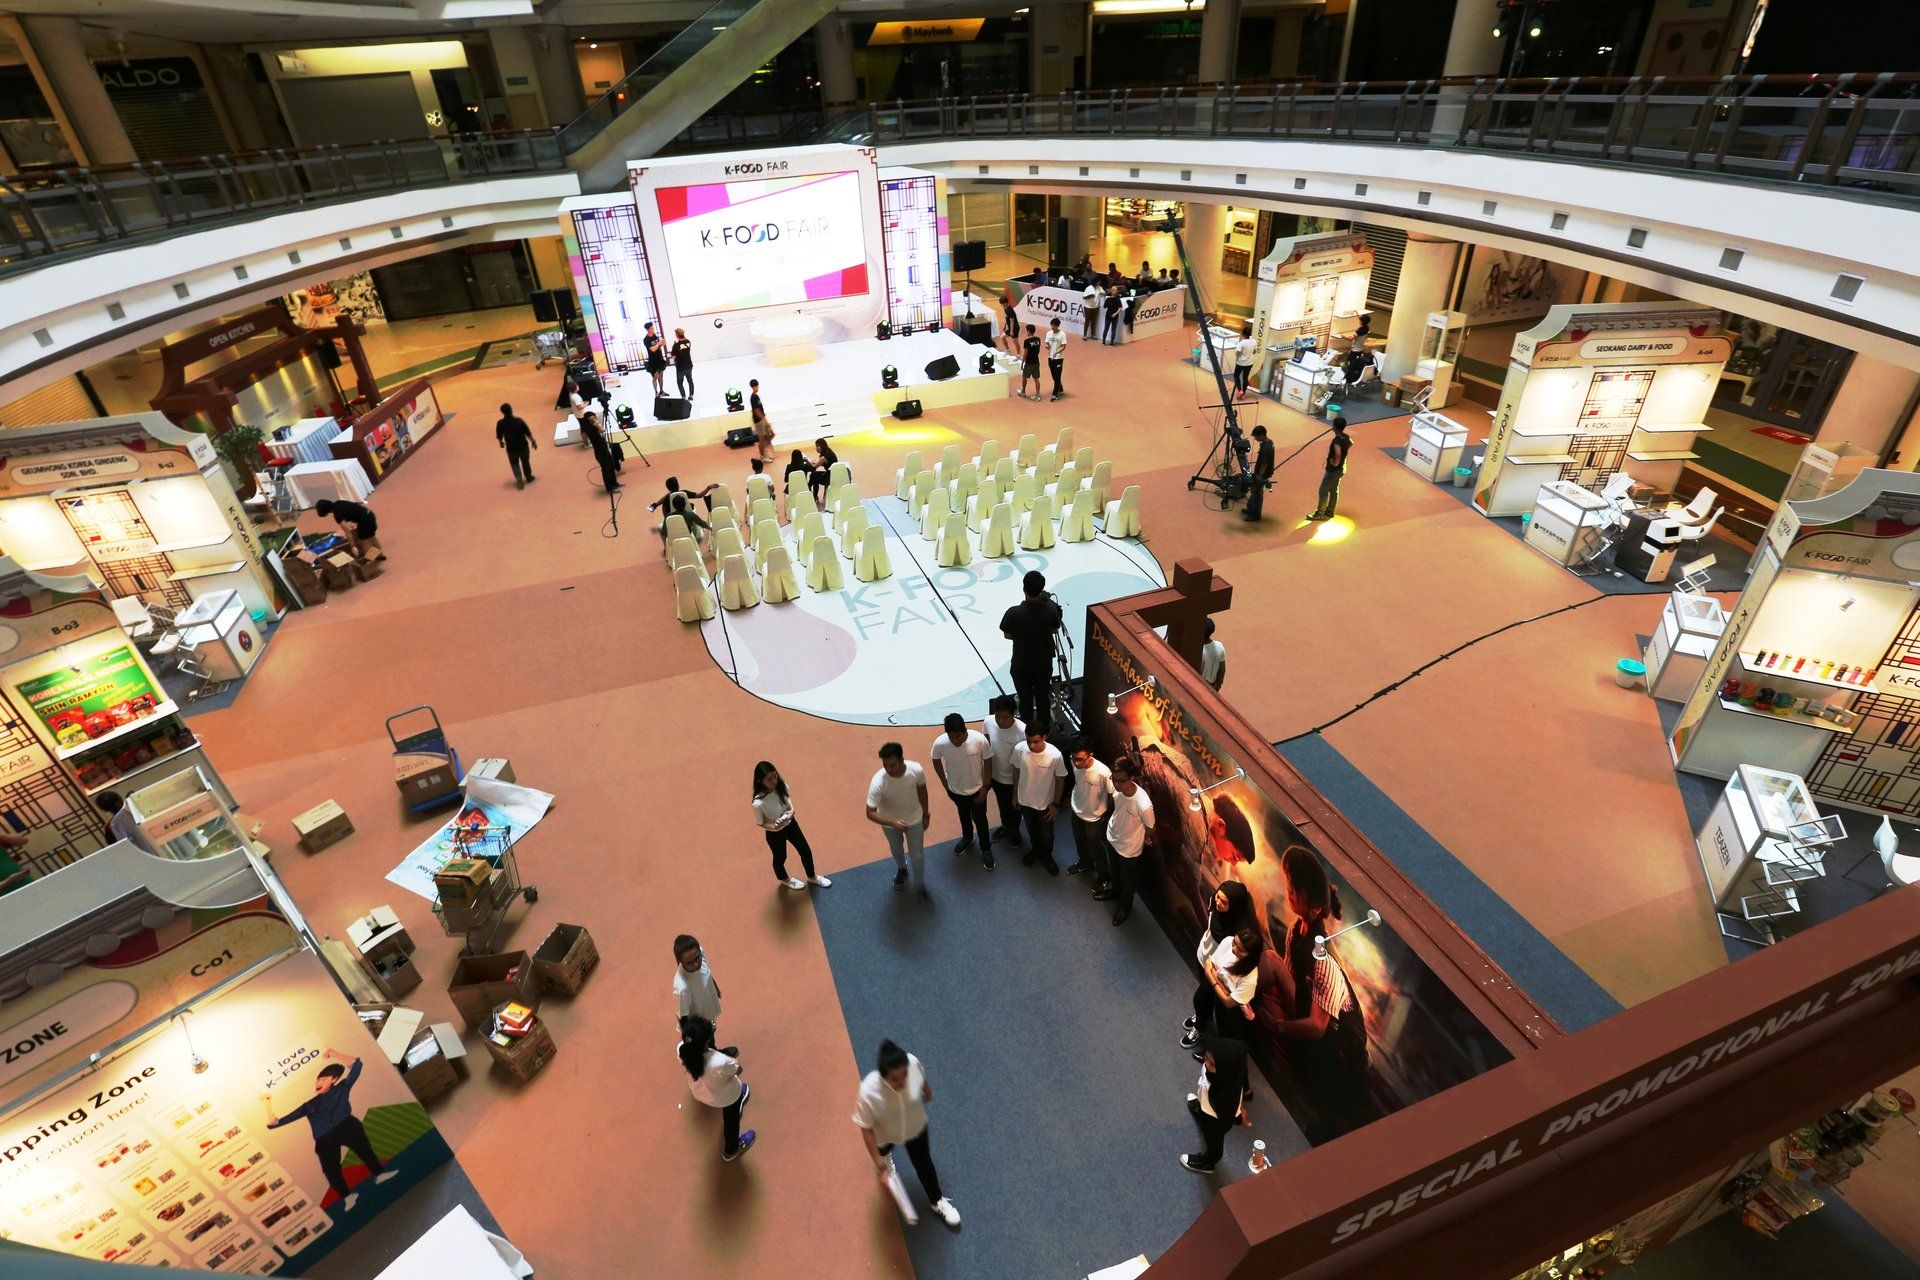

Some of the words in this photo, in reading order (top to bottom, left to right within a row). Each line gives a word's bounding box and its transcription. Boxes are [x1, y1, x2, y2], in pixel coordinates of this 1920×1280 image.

[913, 25, 954, 38] Maybank
[101, 67, 181, 88] ALDO
[724, 163, 763, 175] K-FOOD
[766, 160, 789, 171] FAIR
[700, 223, 780, 248] K-FOOD
[786, 217, 830, 238] FAIR
[1026, 294, 1068, 314] K-FOOD
[1070, 302, 1086, 317] FA
[1160, 303, 1179, 316] FAIR
[208, 332, 229, 348] OPEN
[227, 322, 256, 340] KITCHEN
[1595, 344, 1627, 353] SEOKANG
[1627, 343, 1647, 352] DAIRY
[1647, 343, 1654, 351] &
[1654, 342, 1673, 350] FOOD
[1497, 403, 1512, 441] K-FOOD
[21, 461, 67, 476] GEUMHONG
[67, 459, 94, 470] KOREA
[94, 455, 128, 467] GINSENG
[1491, 440, 1501, 463] FAIR
[60, 469, 79, 479] SDN.
[80, 468, 100, 477] BHD.
[228, 505, 250, 544] K-FOOD
[1804, 551, 1845, 563] K-FOOD
[1846, 556, 1872, 567] FAIR
[840, 553, 1049, 614] K-FOOD
[852, 593, 989, 641] FAIR
[1720, 608, 1748, 662] K-FOOD
[1705, 662, 1721, 693] FAIR
[38, 701, 68, 716] SHIN
[68, 682, 116, 707] RAMYUN
[1092, 621, 1154, 701] Descendants
[1155, 697, 1171, 722] of
[1168, 707, 1190, 740] the
[1190, 732, 1223, 777] Sun
[0, 754, 33, 774] FAIR
[1714, 825, 1732, 867] TEAZEN
[0, 1020, 69, 1065] ZONE
[277, 1047, 306, 1067] love
[265, 1049, 320, 1089] K-FOOD
[87, 1065, 157, 1110] Zone
[36, 1120, 105, 1162] Coupon
[107, 1091, 151, 1122] here!
[1329, 1138, 1524, 1247] SPECIAL
[1538, 991, 1830, 1147] PROMOTIONAL
